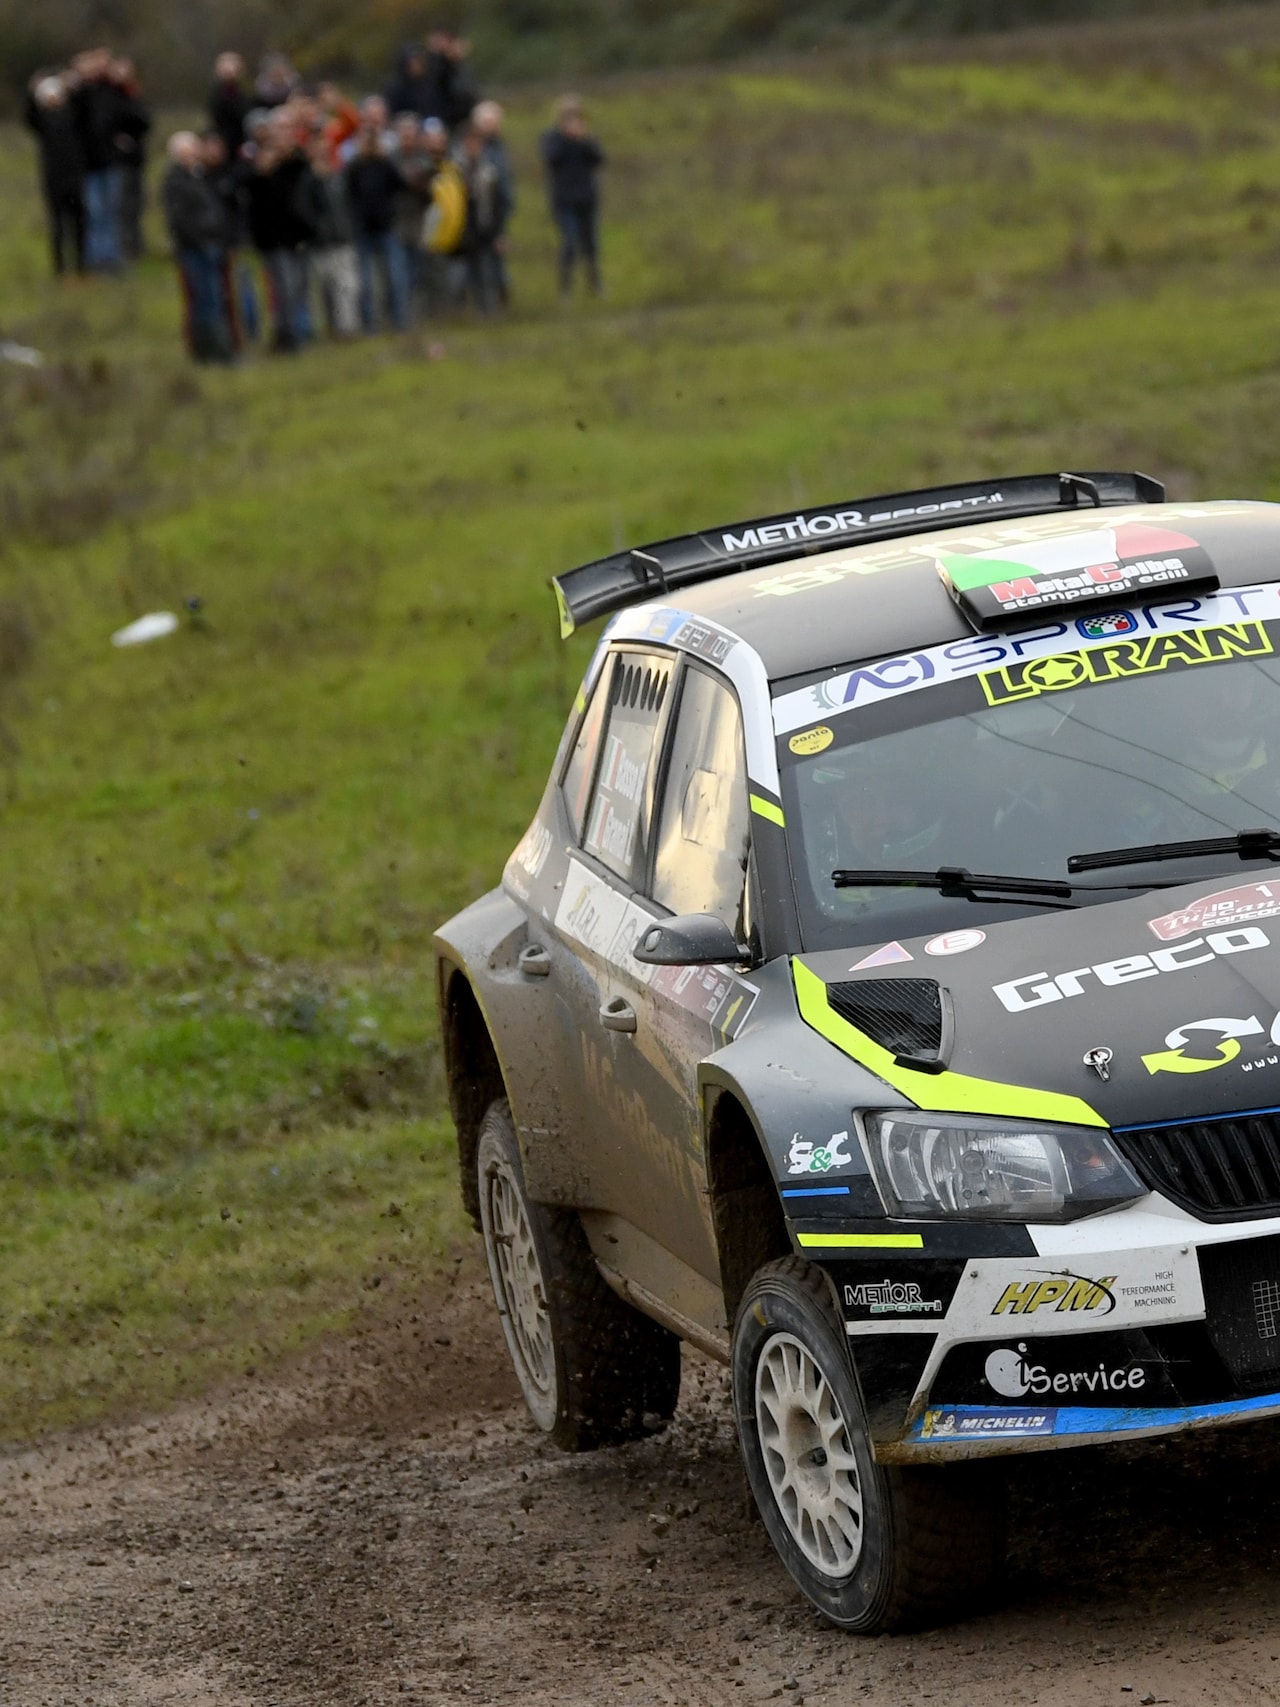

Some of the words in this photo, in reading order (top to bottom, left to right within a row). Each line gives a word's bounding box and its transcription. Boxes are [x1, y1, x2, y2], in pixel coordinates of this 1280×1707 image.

[1003, 580, 1132, 611] stampaggi
[1138, 567, 1190, 584] edili
[1256, 885, 1273, 897] 1
[991, 926, 1271, 1013] Greco
[1155, 1271, 1174, 1281] HIGH
[990, 1276, 1119, 1316] HPM
[1121, 1283, 1175, 1297] PERFORMANCE
[1133, 1296, 1177, 1308] MACHINING
[959, 1415, 1047, 1430] MICHELIN
